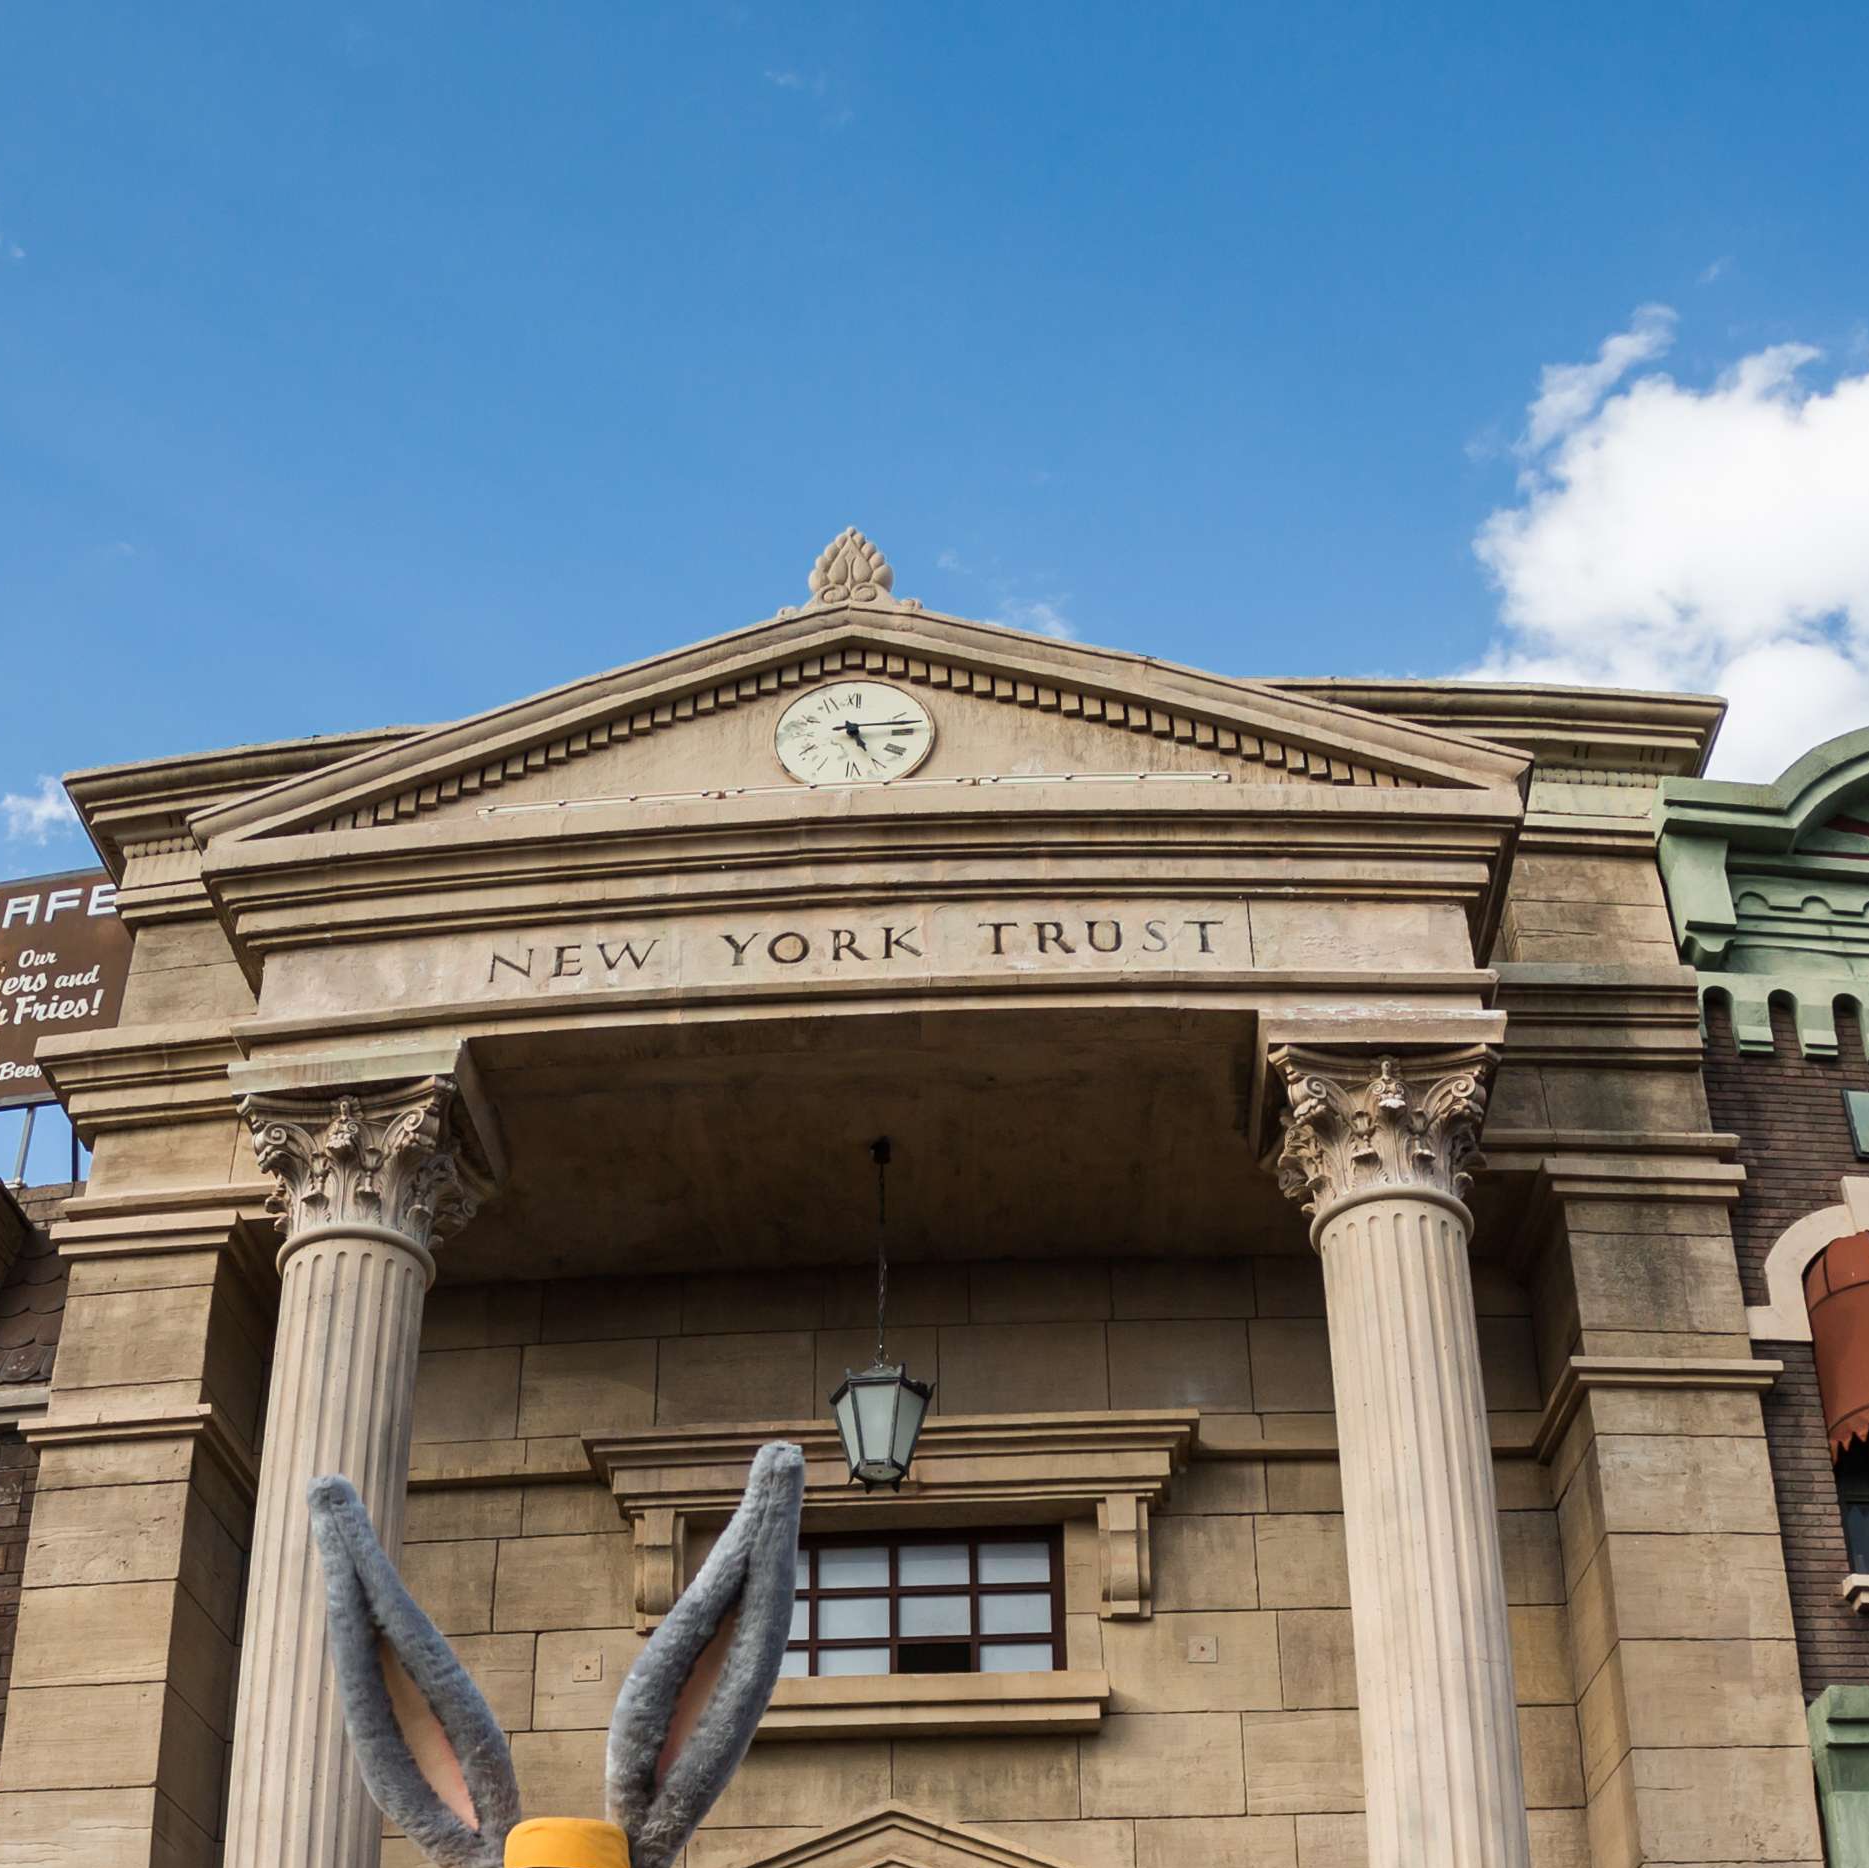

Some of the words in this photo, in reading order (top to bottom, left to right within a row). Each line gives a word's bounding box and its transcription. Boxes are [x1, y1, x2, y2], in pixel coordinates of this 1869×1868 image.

[18, 949, 58, 969] Our
[487, 938, 662, 984] NEW
[721, 925, 925, 967] YORK
[977, 919, 1226, 955] TRUST
[54, 964, 101, 989] and
[13, 988, 105, 1025] Fries!
